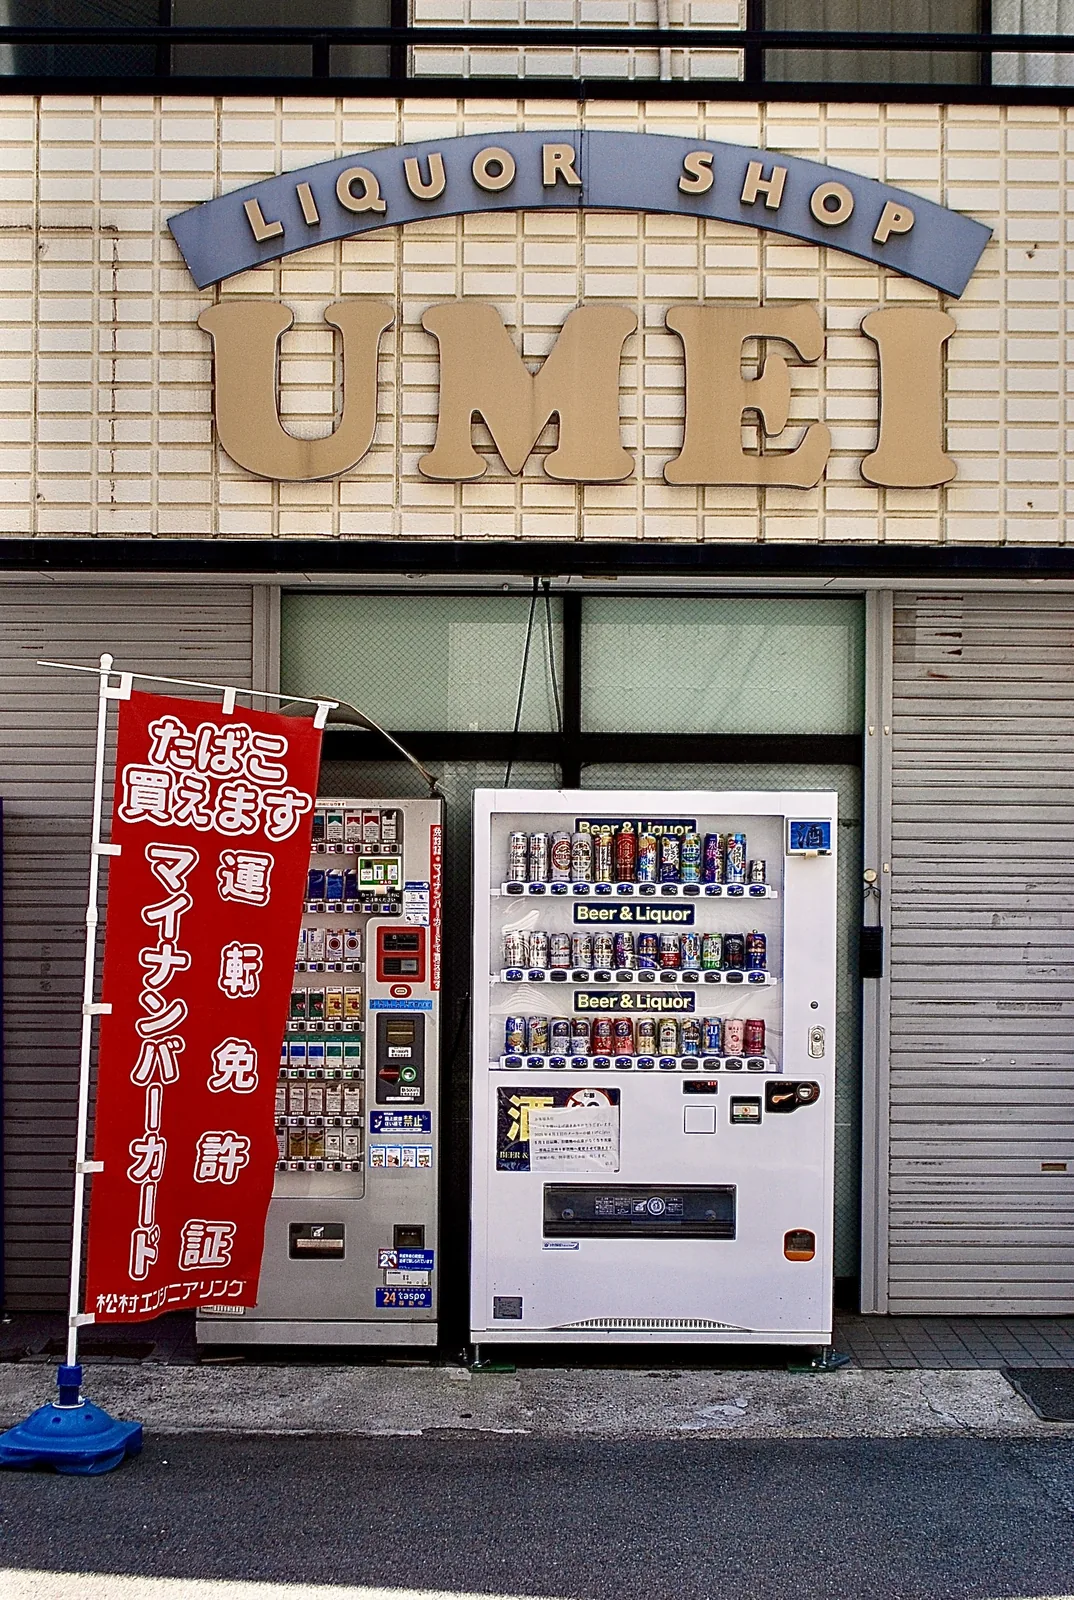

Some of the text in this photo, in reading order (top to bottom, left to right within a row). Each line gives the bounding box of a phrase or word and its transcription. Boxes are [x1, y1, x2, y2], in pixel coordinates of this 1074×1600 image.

[243, 143, 915, 246] LIQUOR SHOP
[197, 301, 959, 489] UMEI
[149, 715, 288, 786] たばこ
[118, 763, 312, 842] 買えます
[579, 821, 692, 836] Beer & Liquor
[797, 823, 824, 848] 酒
[577, 906, 691, 923] Beer & Liquor
[578, 993, 691, 1010] Beer & Liquor
[127, 843, 200, 1281] マイナンバーカード
[179, 849, 274, 1271] 運転免許証
[403, 1115, 423, 1127] 禁止
[499, 1150, 521, 1159] BEER
[383, 1291, 396, 1304] 24
[398, 1292, 426, 1301] taspo
